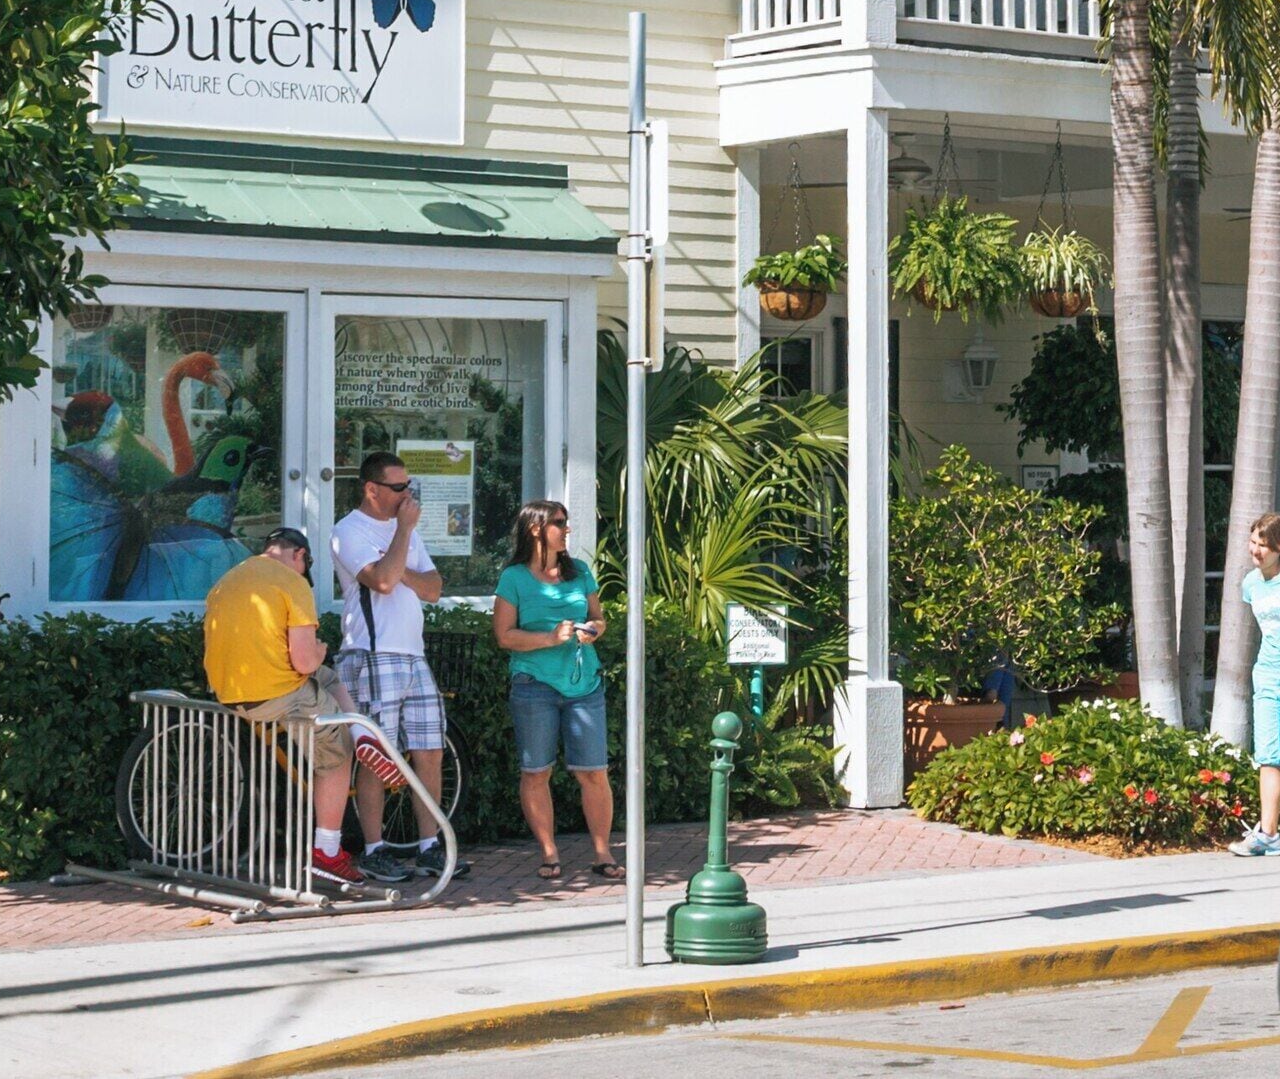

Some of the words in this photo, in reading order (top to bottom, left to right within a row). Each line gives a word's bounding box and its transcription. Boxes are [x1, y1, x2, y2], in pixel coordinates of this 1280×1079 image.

[126, 64, 150, 89] &
[154, 66, 222, 95] NATURE
[227, 72, 361, 104] CONSERVATORY
[386, 352, 404, 363] the
[406, 353, 467, 367] spectacular
[469, 354, 503, 366] colors
[347, 367, 383, 378] nature
[386, 367, 417, 378] when
[420, 369, 440, 380] you
[443, 368, 471, 380] walk
[335, 383, 374, 395] among
[376, 381, 429, 393] hundreds
[432, 382, 444, 394] of
[447, 382, 468, 394] live
[335, 395, 384, 407] utterflies
[387, 396, 408, 407] and
[410, 397, 443, 408] exotic
[445, 397, 477, 408] birds.
